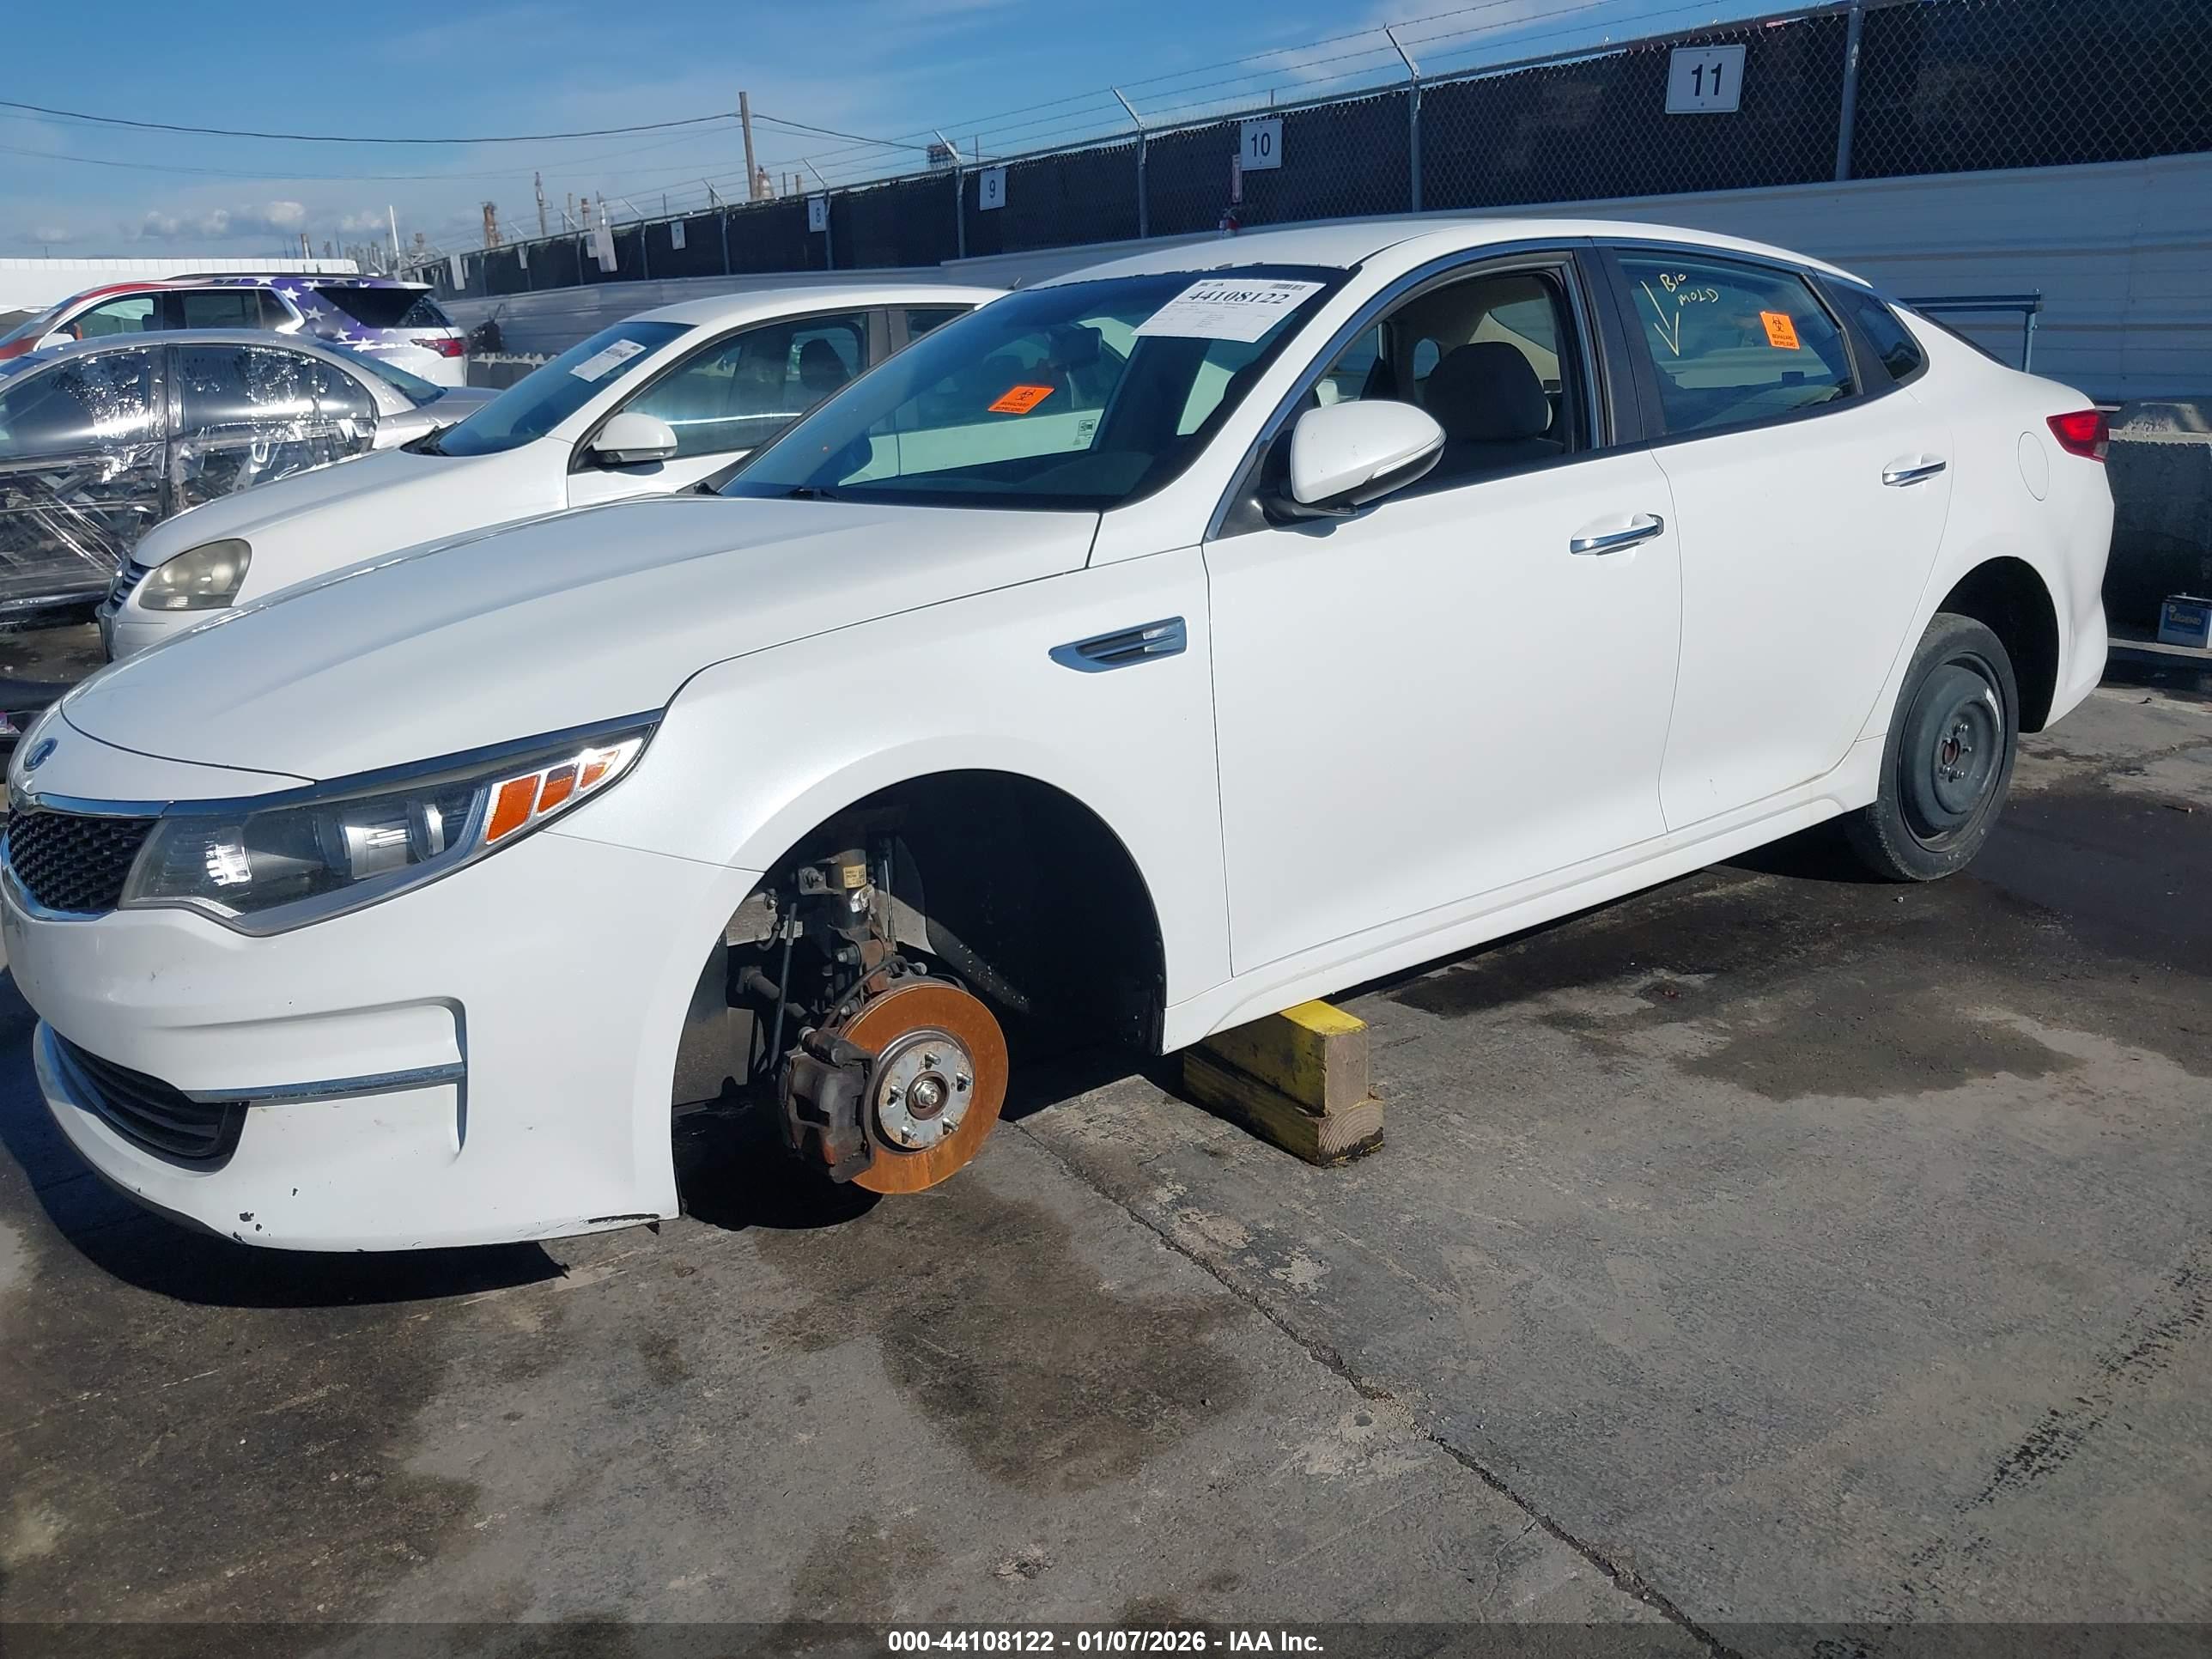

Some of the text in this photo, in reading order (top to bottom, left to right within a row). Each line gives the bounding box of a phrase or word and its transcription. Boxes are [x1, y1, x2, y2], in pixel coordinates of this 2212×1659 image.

[1691, 62, 1723, 97] 11
[1251, 132, 1271, 157] 10
[988, 183, 997, 199] 9
[1188, 289, 1291, 305] 44108122
